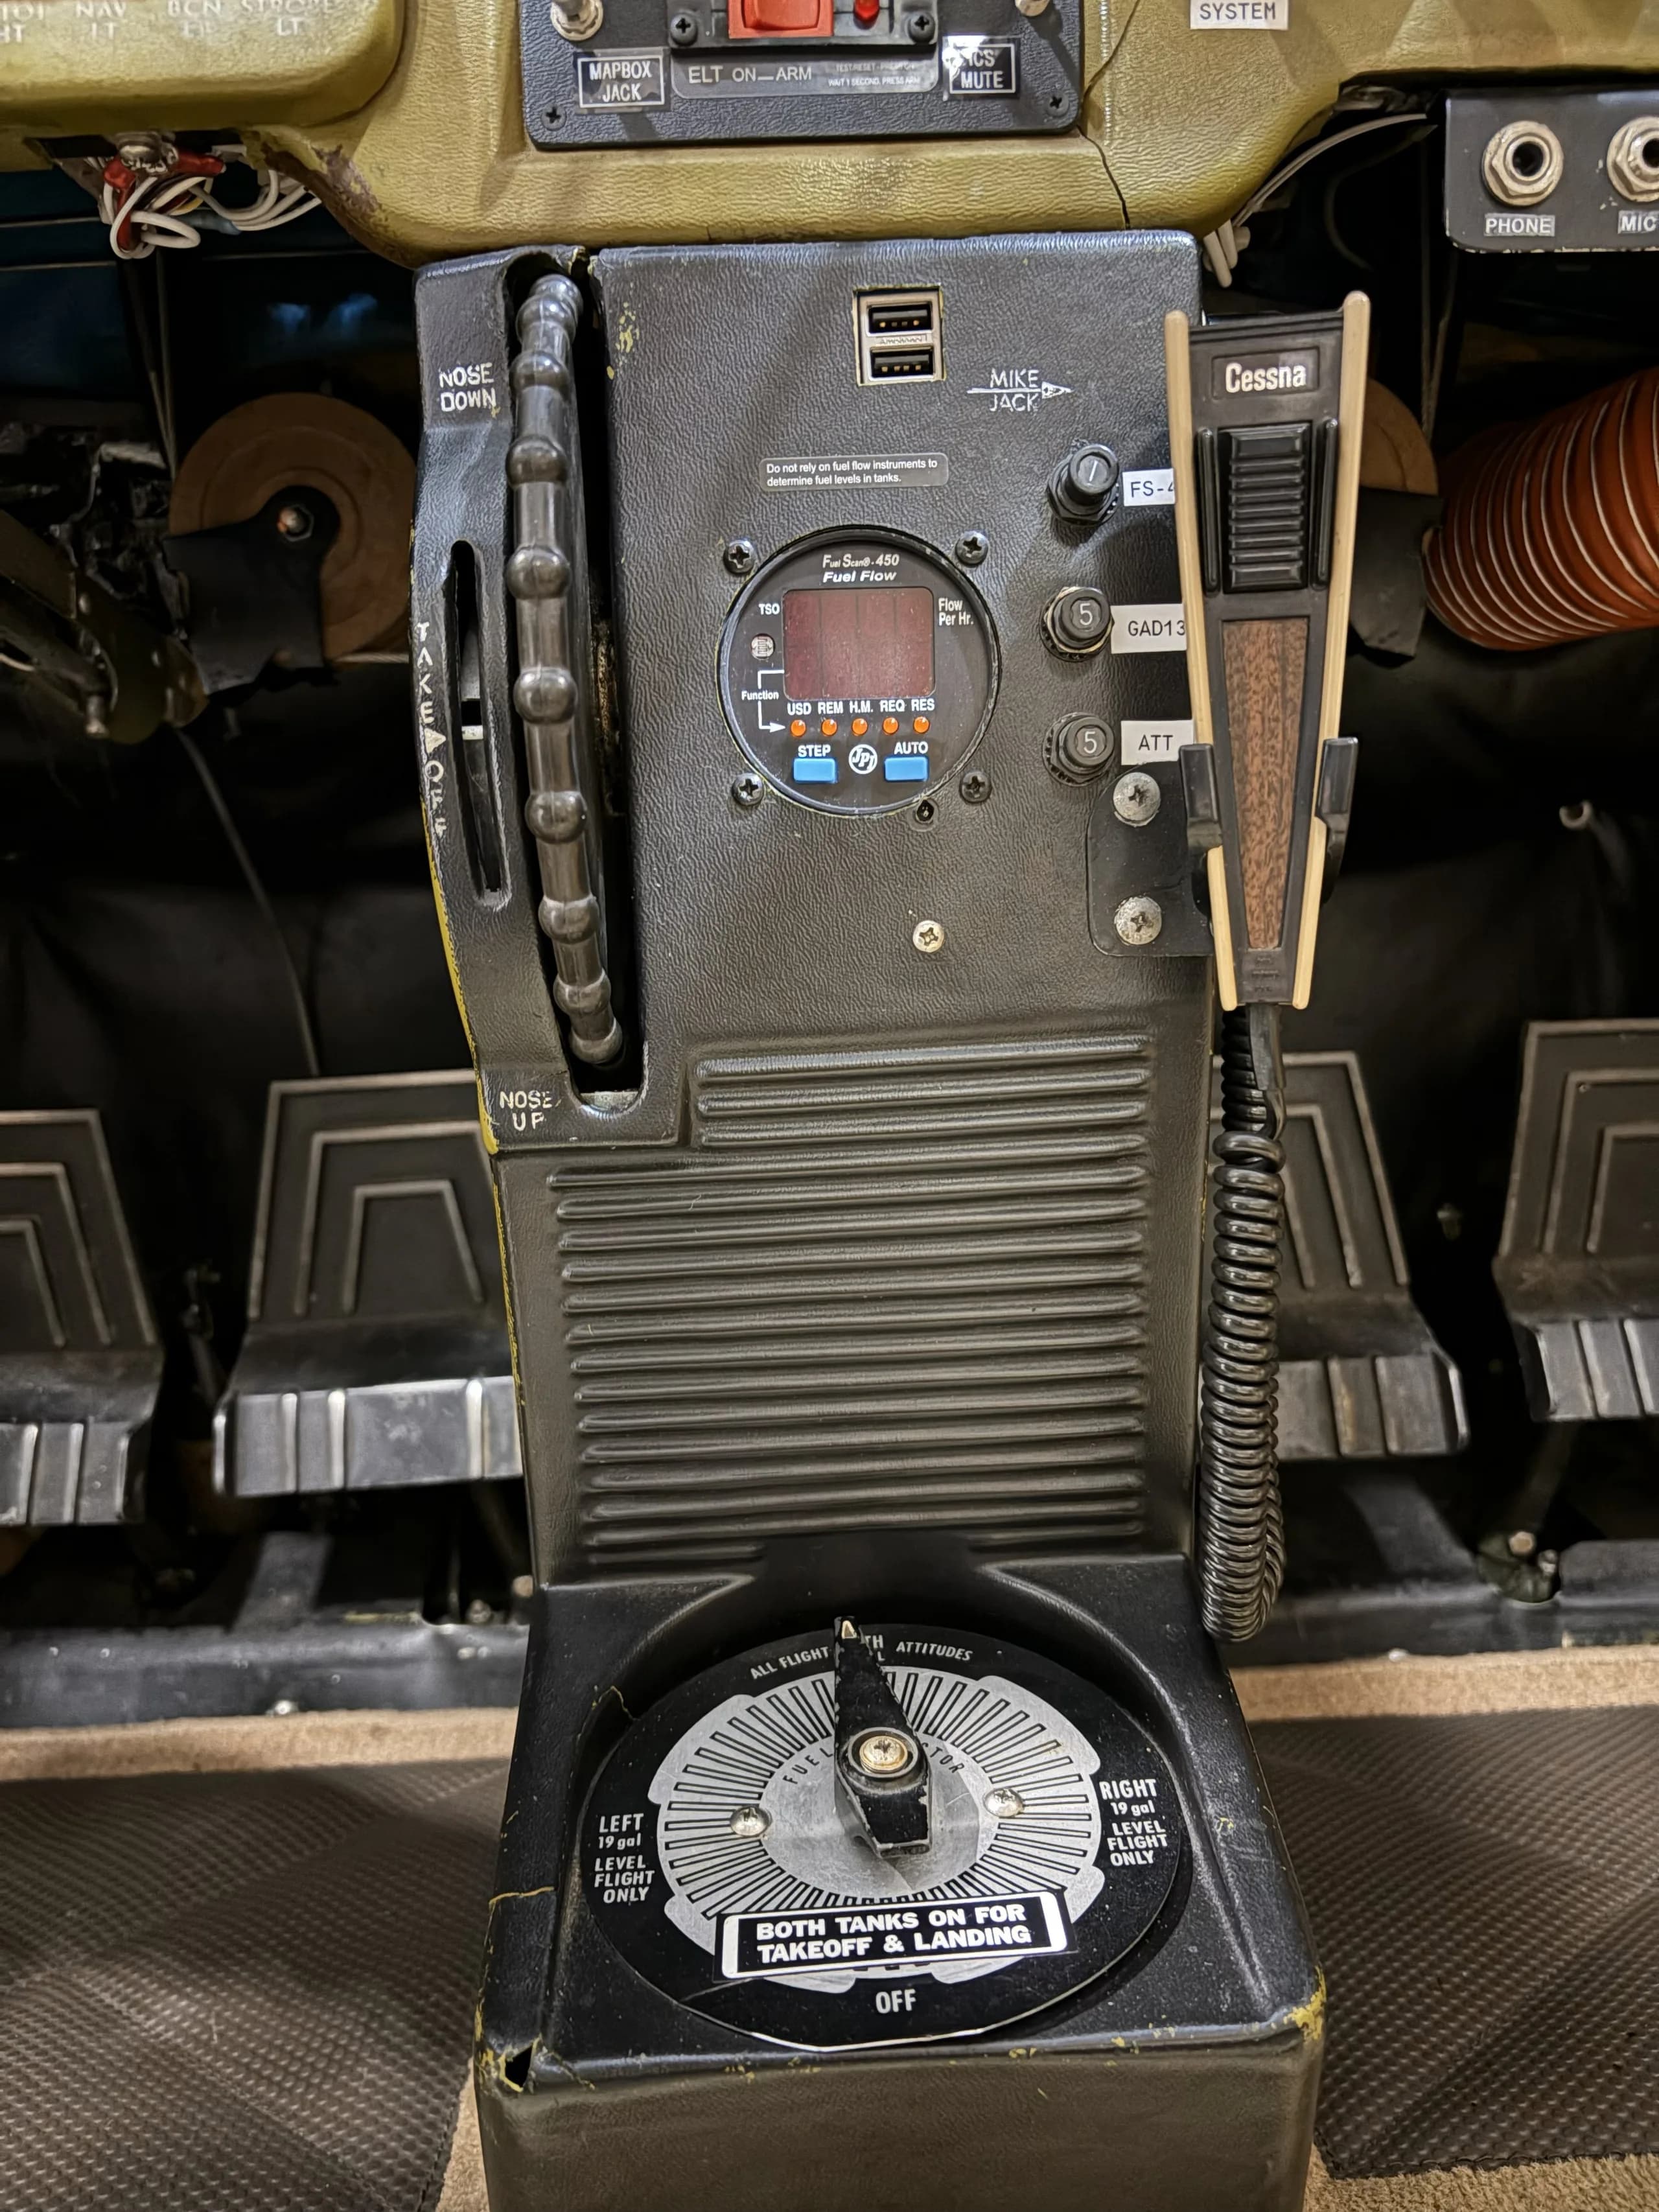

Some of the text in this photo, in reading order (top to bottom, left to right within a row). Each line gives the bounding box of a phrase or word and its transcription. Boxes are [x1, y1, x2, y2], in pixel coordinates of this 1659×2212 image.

[76, 0, 126, 17] NAV
[1200, 2, 1276, 20] SYSTEM
[589, 60, 652, 80] MAPBOX
[688, 65, 723, 84] ELT
[960, 70, 1004, 89] MUTE
[602, 83, 642, 102] JACK
[1485, 217, 1552, 235] PHONE
[1621, 215, 1657, 232] MIC
[439, 362, 494, 388] NOSE
[990, 367, 1039, 389] MIKE
[1225, 362, 1307, 393] Cessna
[440, 388, 497, 412] DOWN
[990, 393, 1039, 412] JACK
[766, 463, 780, 474] Do
[782, 463, 797, 473] not
[799, 461, 816, 474] rely
[833, 461, 850, 472] fuel
[852, 460, 871, 471] flow
[873, 459, 927, 470] instruments
[927, 458, 938, 468] to
[767, 472, 901, 487] determine fuel levels in tanks.
[822, 570, 898, 583] Fuel Flow
[759, 603, 780, 616] TSO
[938, 597, 963, 612] Flow
[938, 611, 974, 626] Per Hr.
[1079, 602, 1093, 626] 5
[741, 690, 780, 701] Function
[787, 698, 936, 716] USD REM H.M. REQ RES
[893, 741, 929, 754] AUTO
[1083, 730, 1097, 754] 5
[1137, 734, 1174, 751] ATT
[797, 745, 831, 758] STEP
[499, 1089, 553, 1109] NOSE
[512, 1112, 545, 1132] UP
[749, 1660, 778, 1680] ALL
[778, 1646, 830, 1670] FLIGHT
[896, 1640, 974, 1662] ATTITUDES
[782, 1747, 834, 1785] FUEL
[1098, 1778, 1157, 1800] RIGHT
[1109, 1799, 1155, 1817] 19 gal
[599, 1812, 645, 1834] LEFT
[1111, 1819, 1166, 1836] LEVEL
[597, 1832, 642, 1850] 19 gal
[1106, 1833, 1168, 1851] FLIGHT
[594, 1854, 646, 1872] LEVEL
[1109, 1849, 1155, 1867] ONLY
[594, 1870, 656, 1888] FLIGHT
[603, 1886, 650, 1904] ONLY
[756, 1903, 1027, 1941] BOTH TANKS ON FOR
[756, 1924, 1032, 1964] TAKEOFF & LANDING
[876, 1988, 917, 2014] OFF
